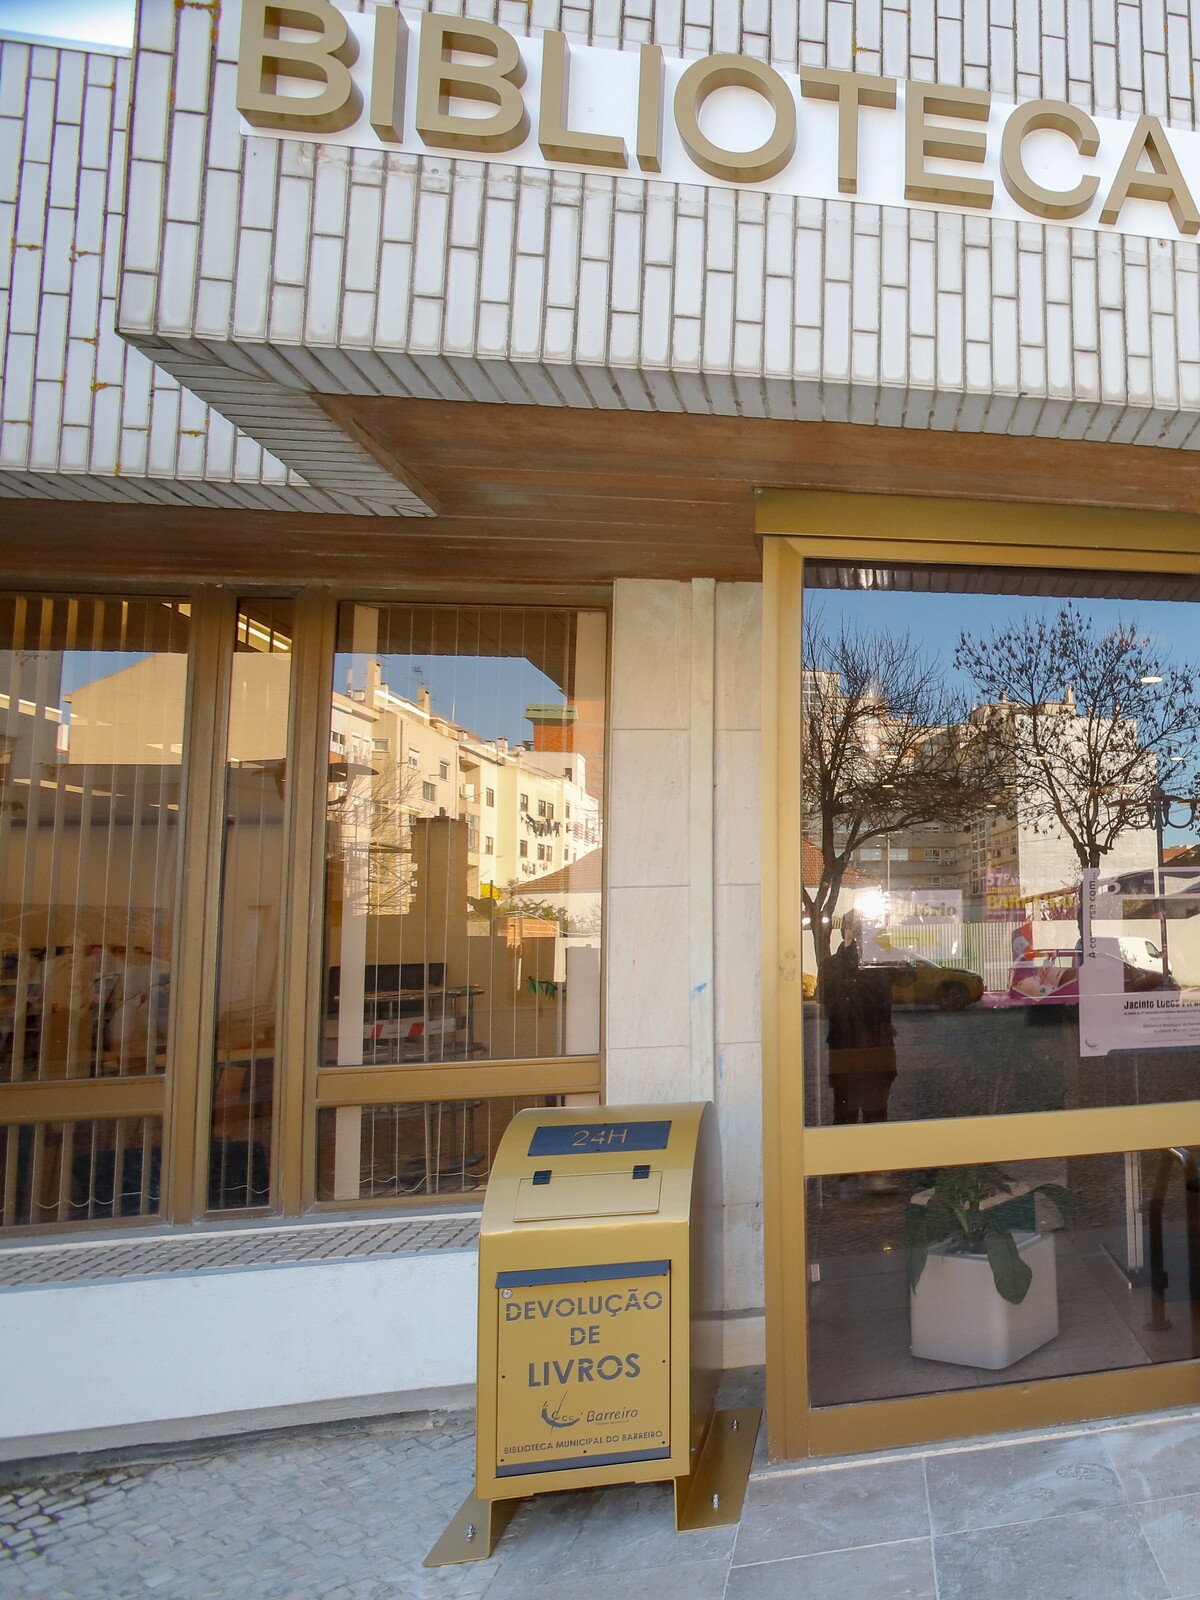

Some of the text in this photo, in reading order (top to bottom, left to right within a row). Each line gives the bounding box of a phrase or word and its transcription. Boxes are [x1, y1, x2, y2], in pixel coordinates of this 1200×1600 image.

[1088, 904, 1097, 948] corsa
[1124, 1000, 1154, 1009] Jacinto
[572, 1128, 628, 1148] 24H
[505, 1288, 663, 1322] DEVOLUÇÃO
[570, 1325, 600, 1346] DE
[528, 1353, 641, 1388] LIVROS
[586, 1406, 638, 1422] Barreiro
[504, 1430, 663, 1455] BIBLIOTECA MUNICIPAL DO BARREIRO
